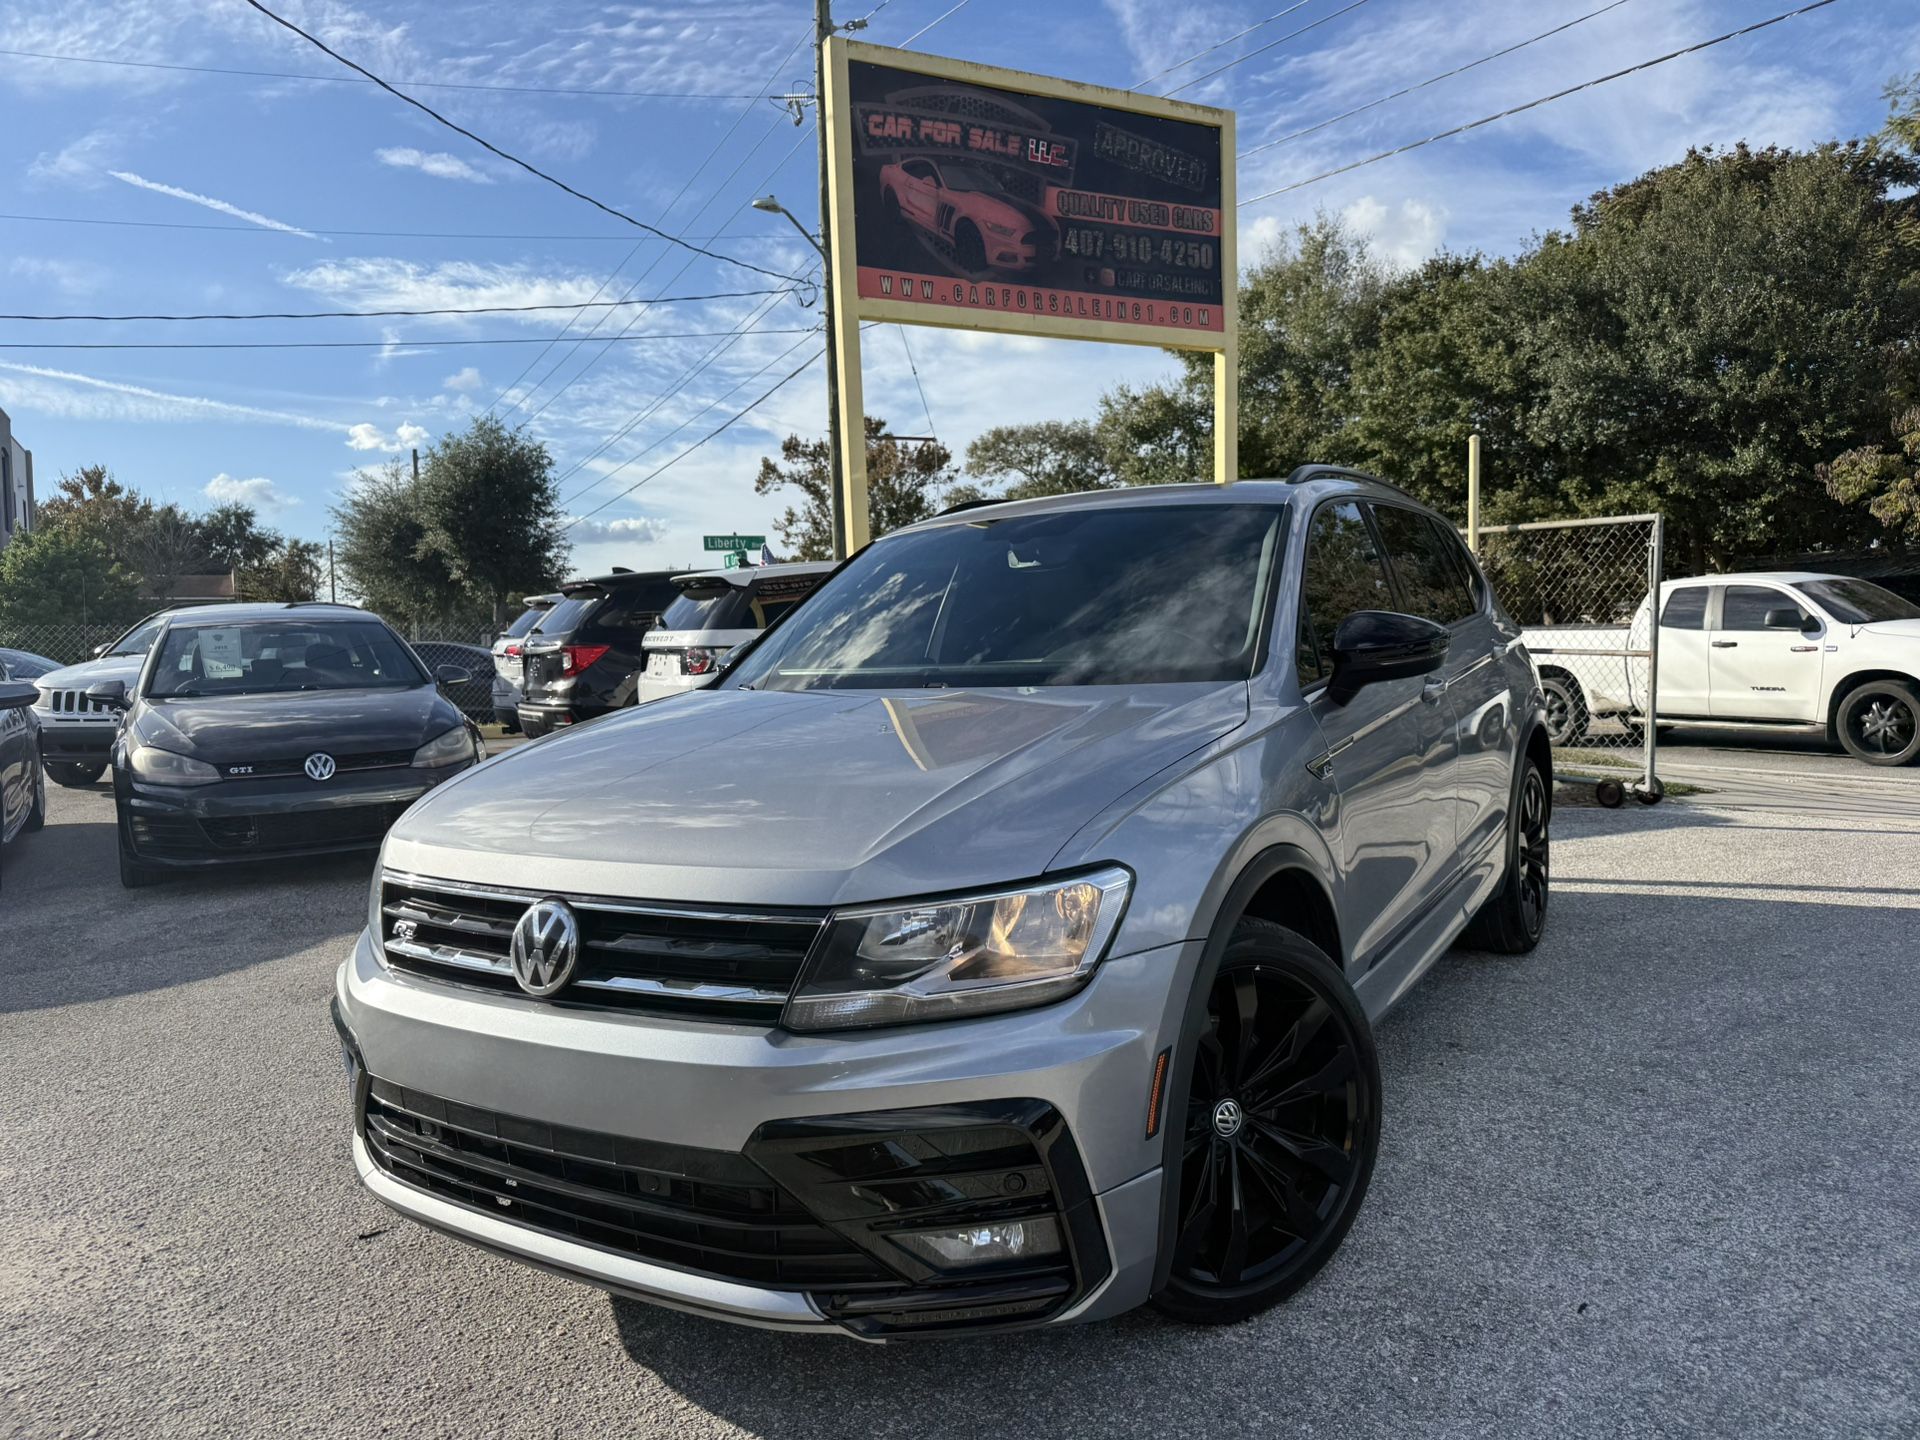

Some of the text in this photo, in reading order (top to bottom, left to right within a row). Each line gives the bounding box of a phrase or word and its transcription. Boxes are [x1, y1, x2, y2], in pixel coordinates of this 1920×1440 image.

[868, 114, 912, 139] CAR
[920, 120, 961, 145] FOR
[969, 128, 1021, 155] SALE
[1101, 130, 1201, 184] APPROVED
[1056, 190, 1214, 232] QUALITY USED CARS
[707, 537, 746, 549] Liberty
[229, 766, 254, 774] GTI
